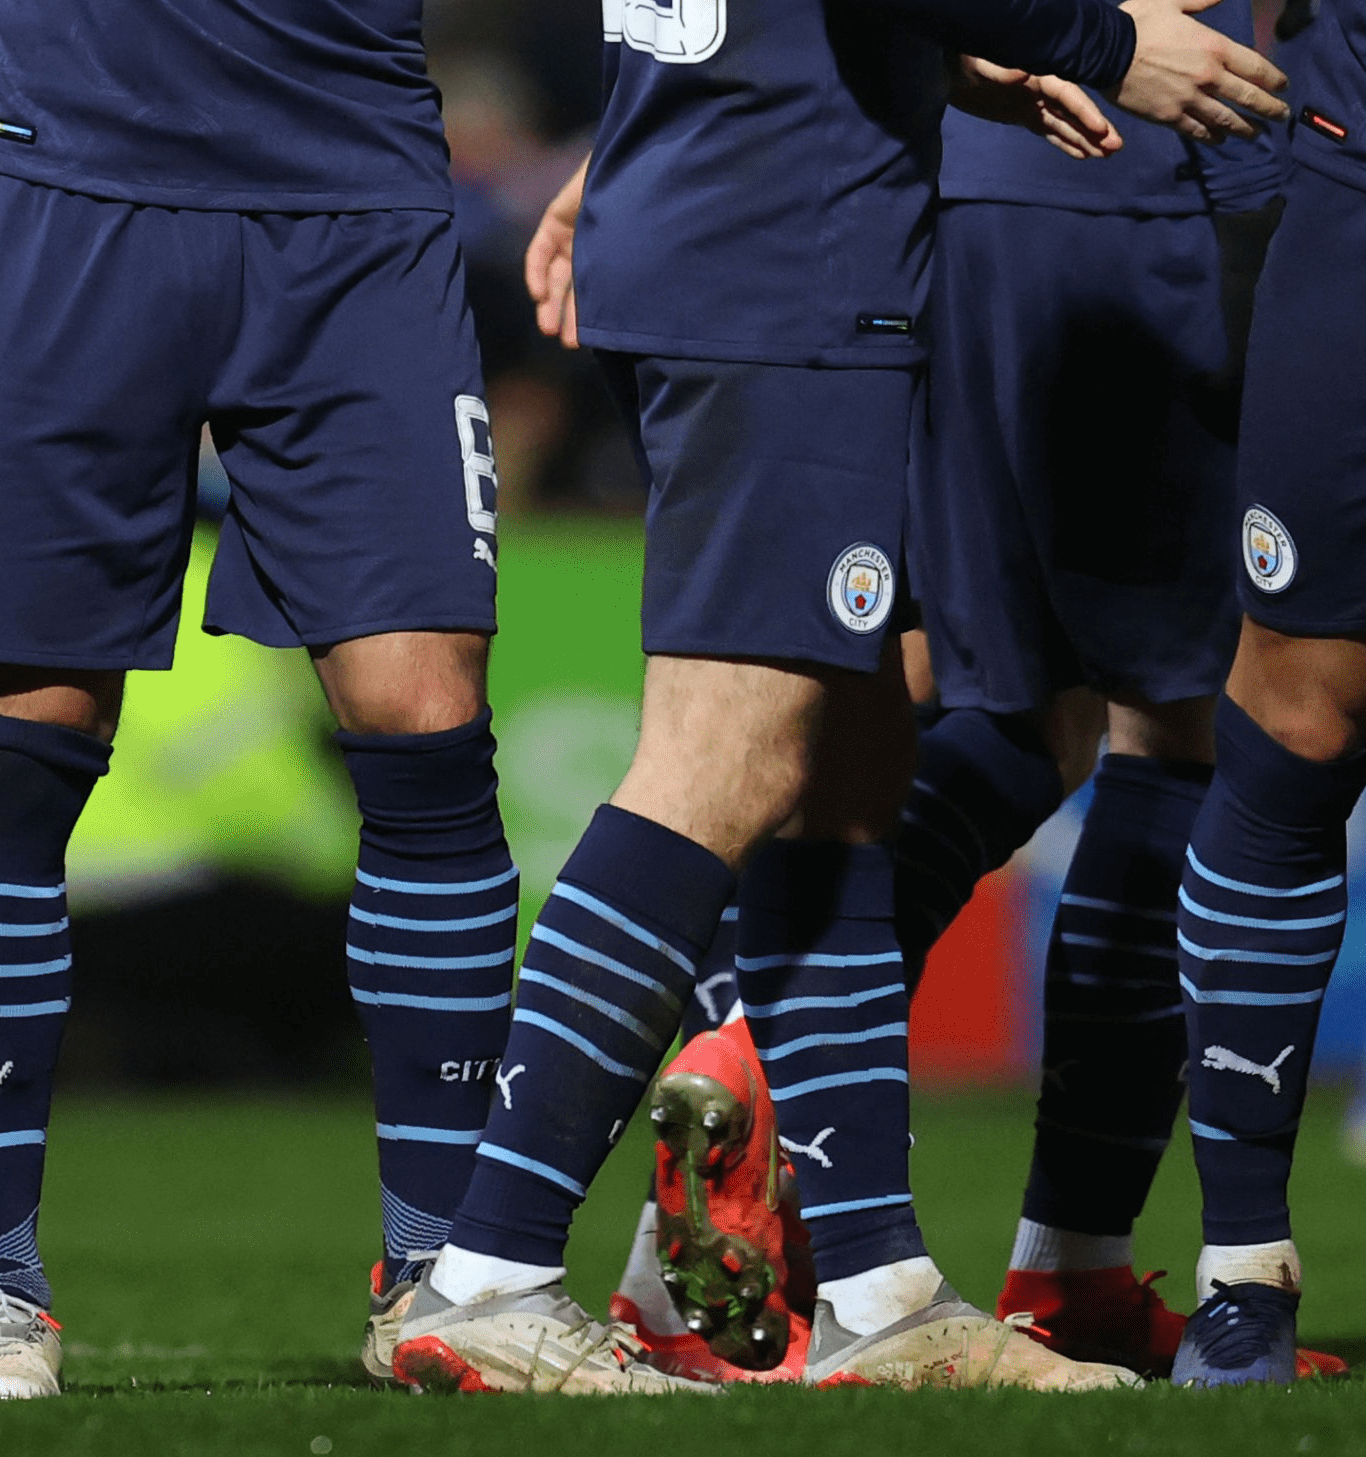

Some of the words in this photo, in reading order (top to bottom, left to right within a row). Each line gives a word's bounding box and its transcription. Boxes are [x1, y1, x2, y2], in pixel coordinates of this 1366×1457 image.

[839, 549, 890, 581] MANCHESTER
[848, 618, 868, 628] CITY
[439, 1057, 501, 1082] CIT
